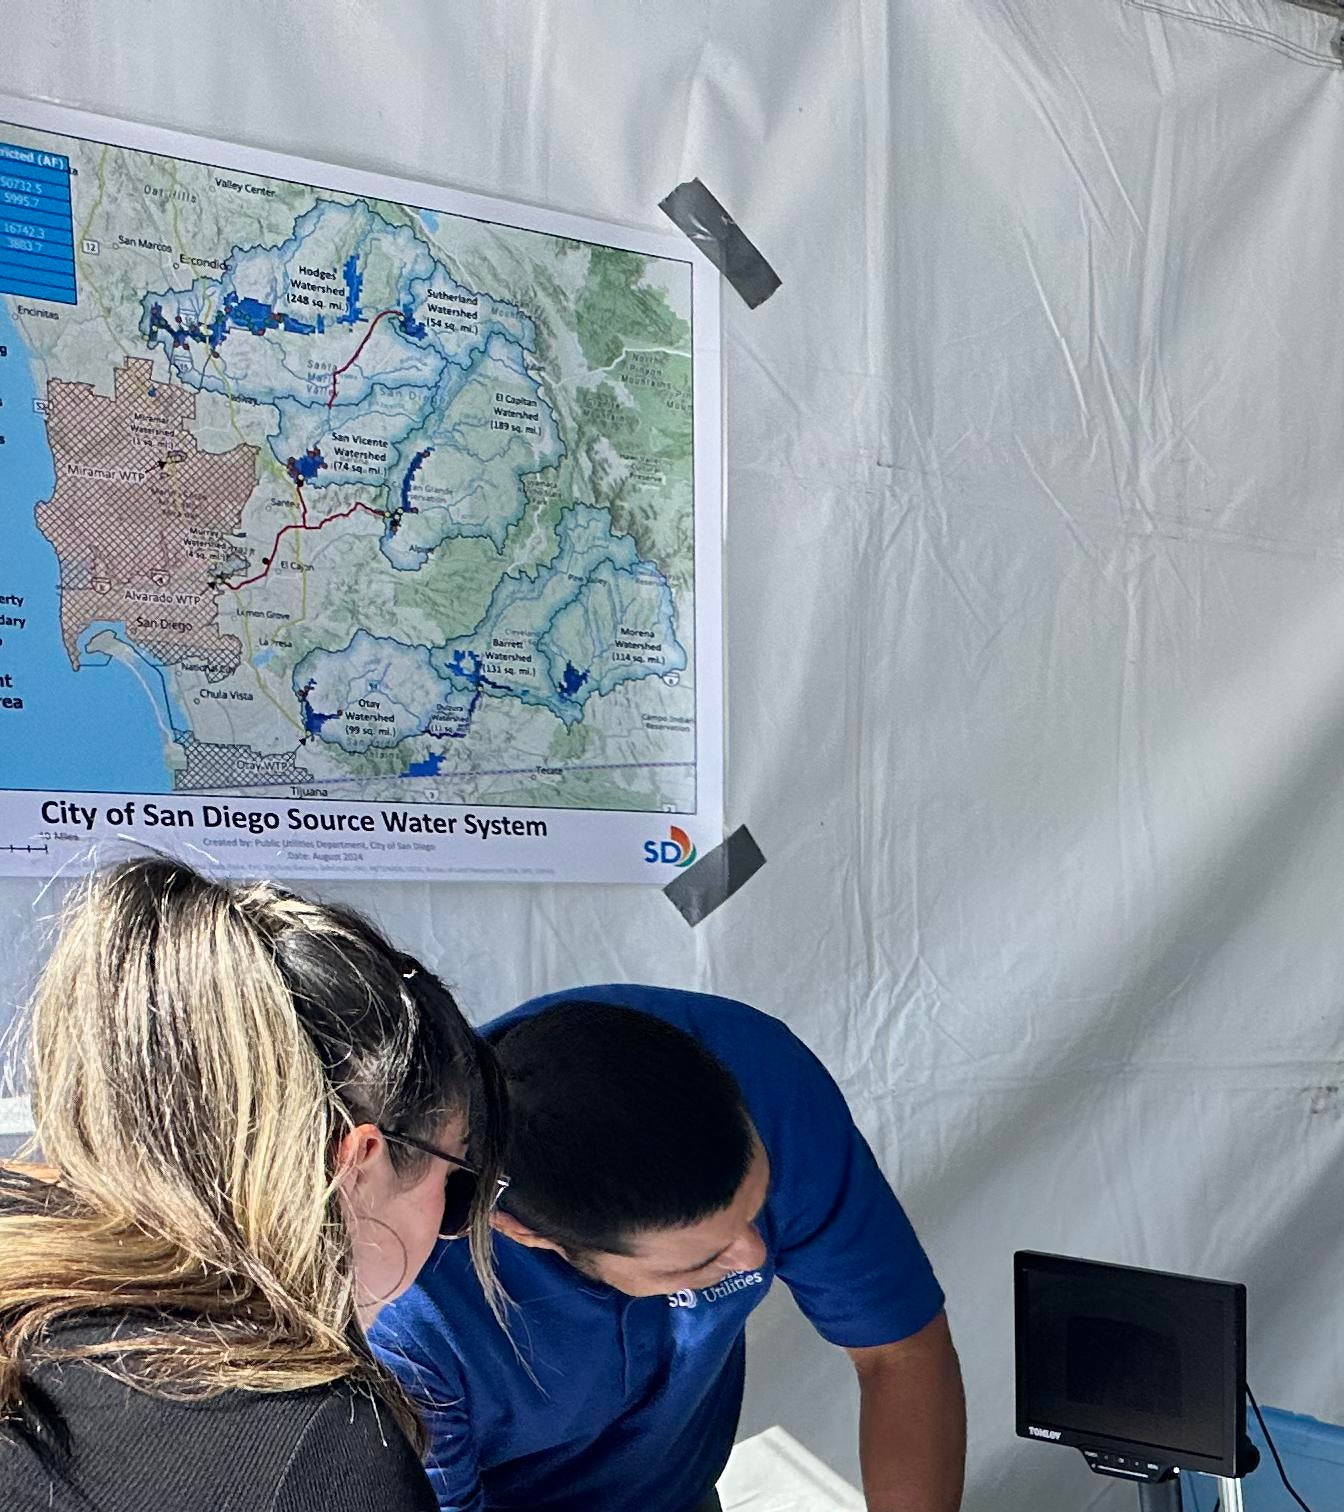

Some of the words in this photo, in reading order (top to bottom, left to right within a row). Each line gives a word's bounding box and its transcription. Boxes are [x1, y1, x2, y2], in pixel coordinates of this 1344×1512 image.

[214, 177, 243, 192] Valley
[245, 181, 276, 197] Center
[118, 235, 135, 247] San
[137, 237, 172, 253] Marcos
[299, 265, 336, 281] Hodges
[291, 279, 345, 297] Watershed
[286, 293, 308, 306] (248
[199, 688, 226, 700] Chula
[229, 689, 253, 701] Vista
[358, 699, 380, 711] Otay
[345, 712, 394, 723] Watershed
[42, 801, 97, 829] City
[102, 802, 135, 825] of
[144, 804, 193, 827] San
[203, 805, 280, 833] Diego
[289, 809, 375, 832] Source
[382, 811, 457, 834] Water
[464, 813, 547, 840] System
[644, 840, 681, 864] SD
[702, 1272, 762, 1302] Utilities
